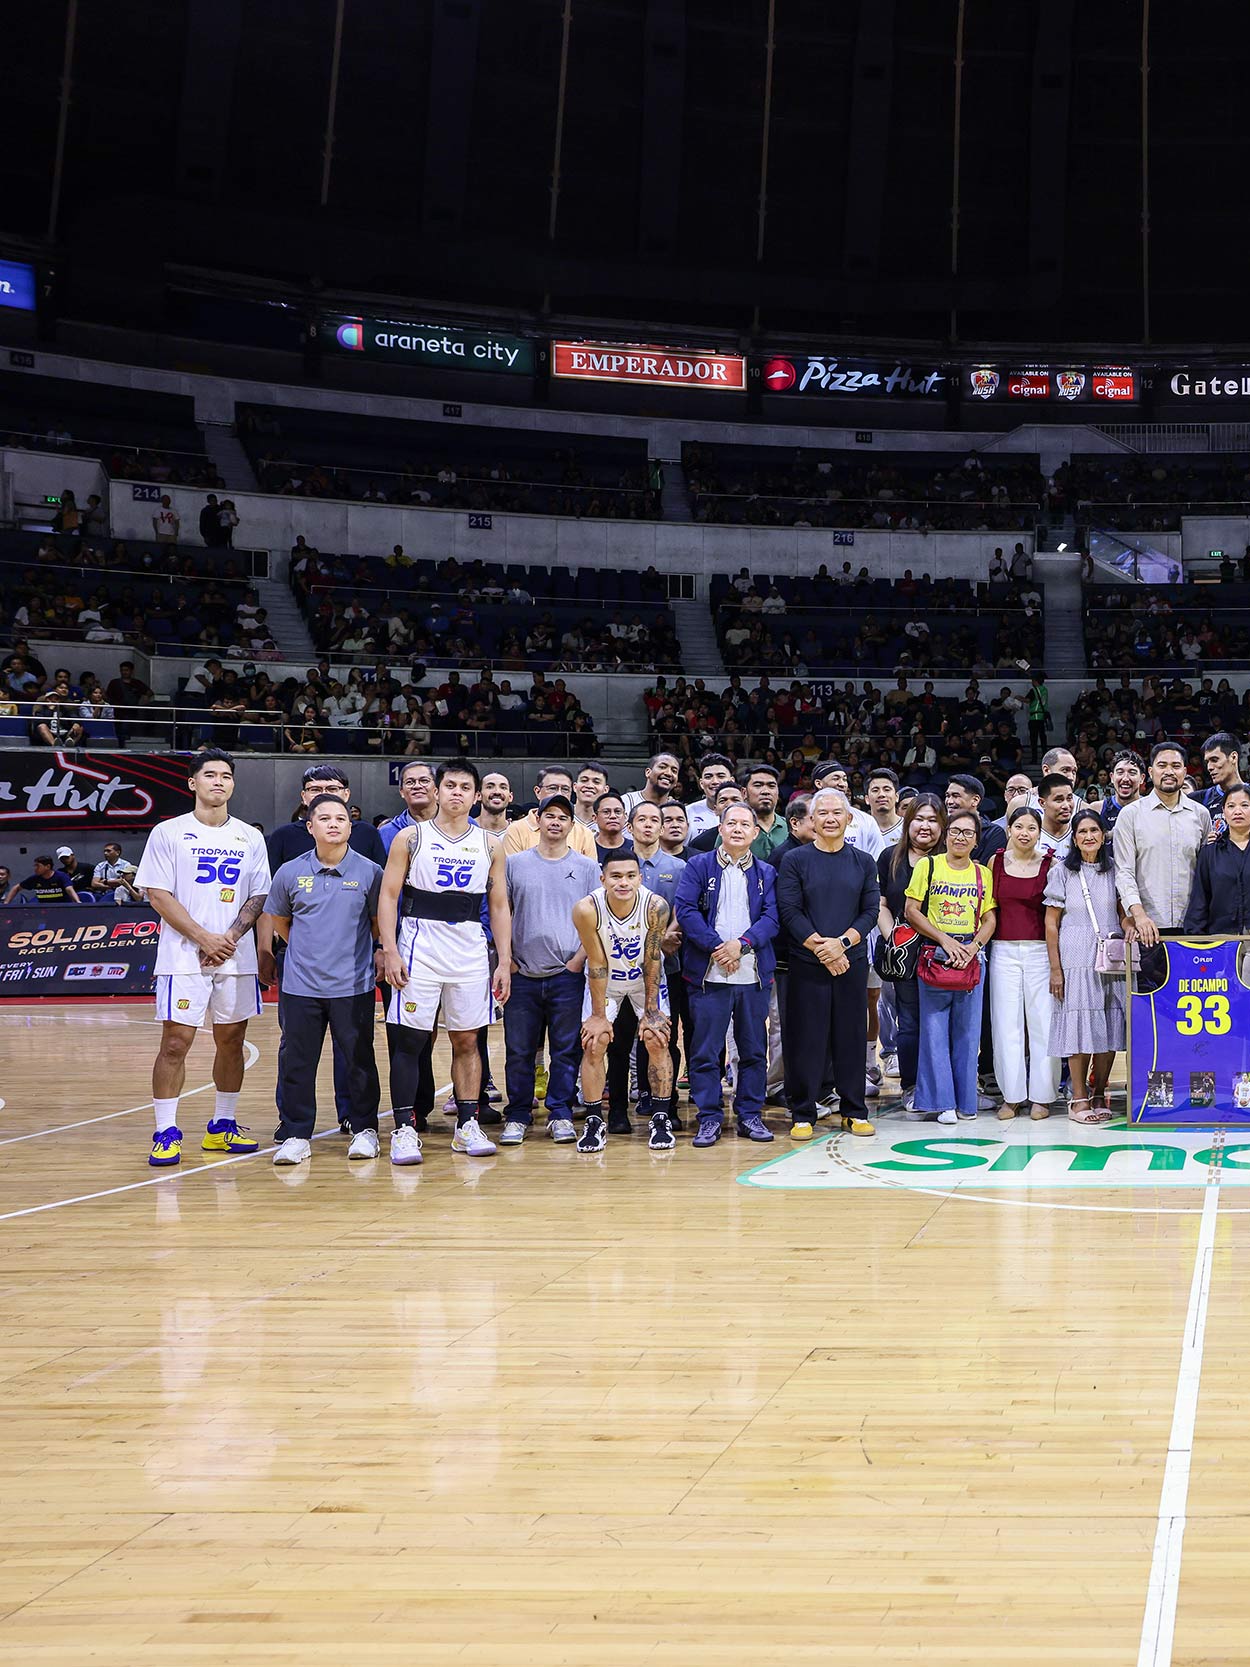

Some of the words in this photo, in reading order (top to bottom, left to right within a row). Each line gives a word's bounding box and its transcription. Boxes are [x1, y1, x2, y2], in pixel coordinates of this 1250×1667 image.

[375, 333, 465, 356] araneta
[473, 341, 519, 366] city
[571, 352, 727, 381] EMPERADOR
[749, 368, 761, 379] 10
[799, 361, 881, 391] Pizza
[884, 367, 946, 394] Hut
[1011, 384, 1046, 396] Cignal
[1095, 385, 1130, 398] Cignal
[134, 486, 160, 499] 214
[470, 515, 491, 527] 215
[834, 532, 853, 544] 216
[810, 684, 833, 696] 113
[23, 768, 136, 812] Hut
[191, 848, 245, 858] TROPANG
[433, 857, 476, 866] TROPANG
[195, 857, 242, 885] 5G
[435, 864, 473, 888] 5G
[8, 925, 107, 949] SOLID
[18, 946, 54, 956] RACE
[60, 944, 77, 952] TO
[82, 939, 136, 950] GOLDEN
[0, 961, 34, 969] EVERY
[2, 969, 24, 982] FRI
[32, 966, 59, 979] SUN
[1178, 979, 1190, 992] DE
[1191, 978, 1229, 993] OCAMPO
[1176, 995, 1232, 1035] 33
